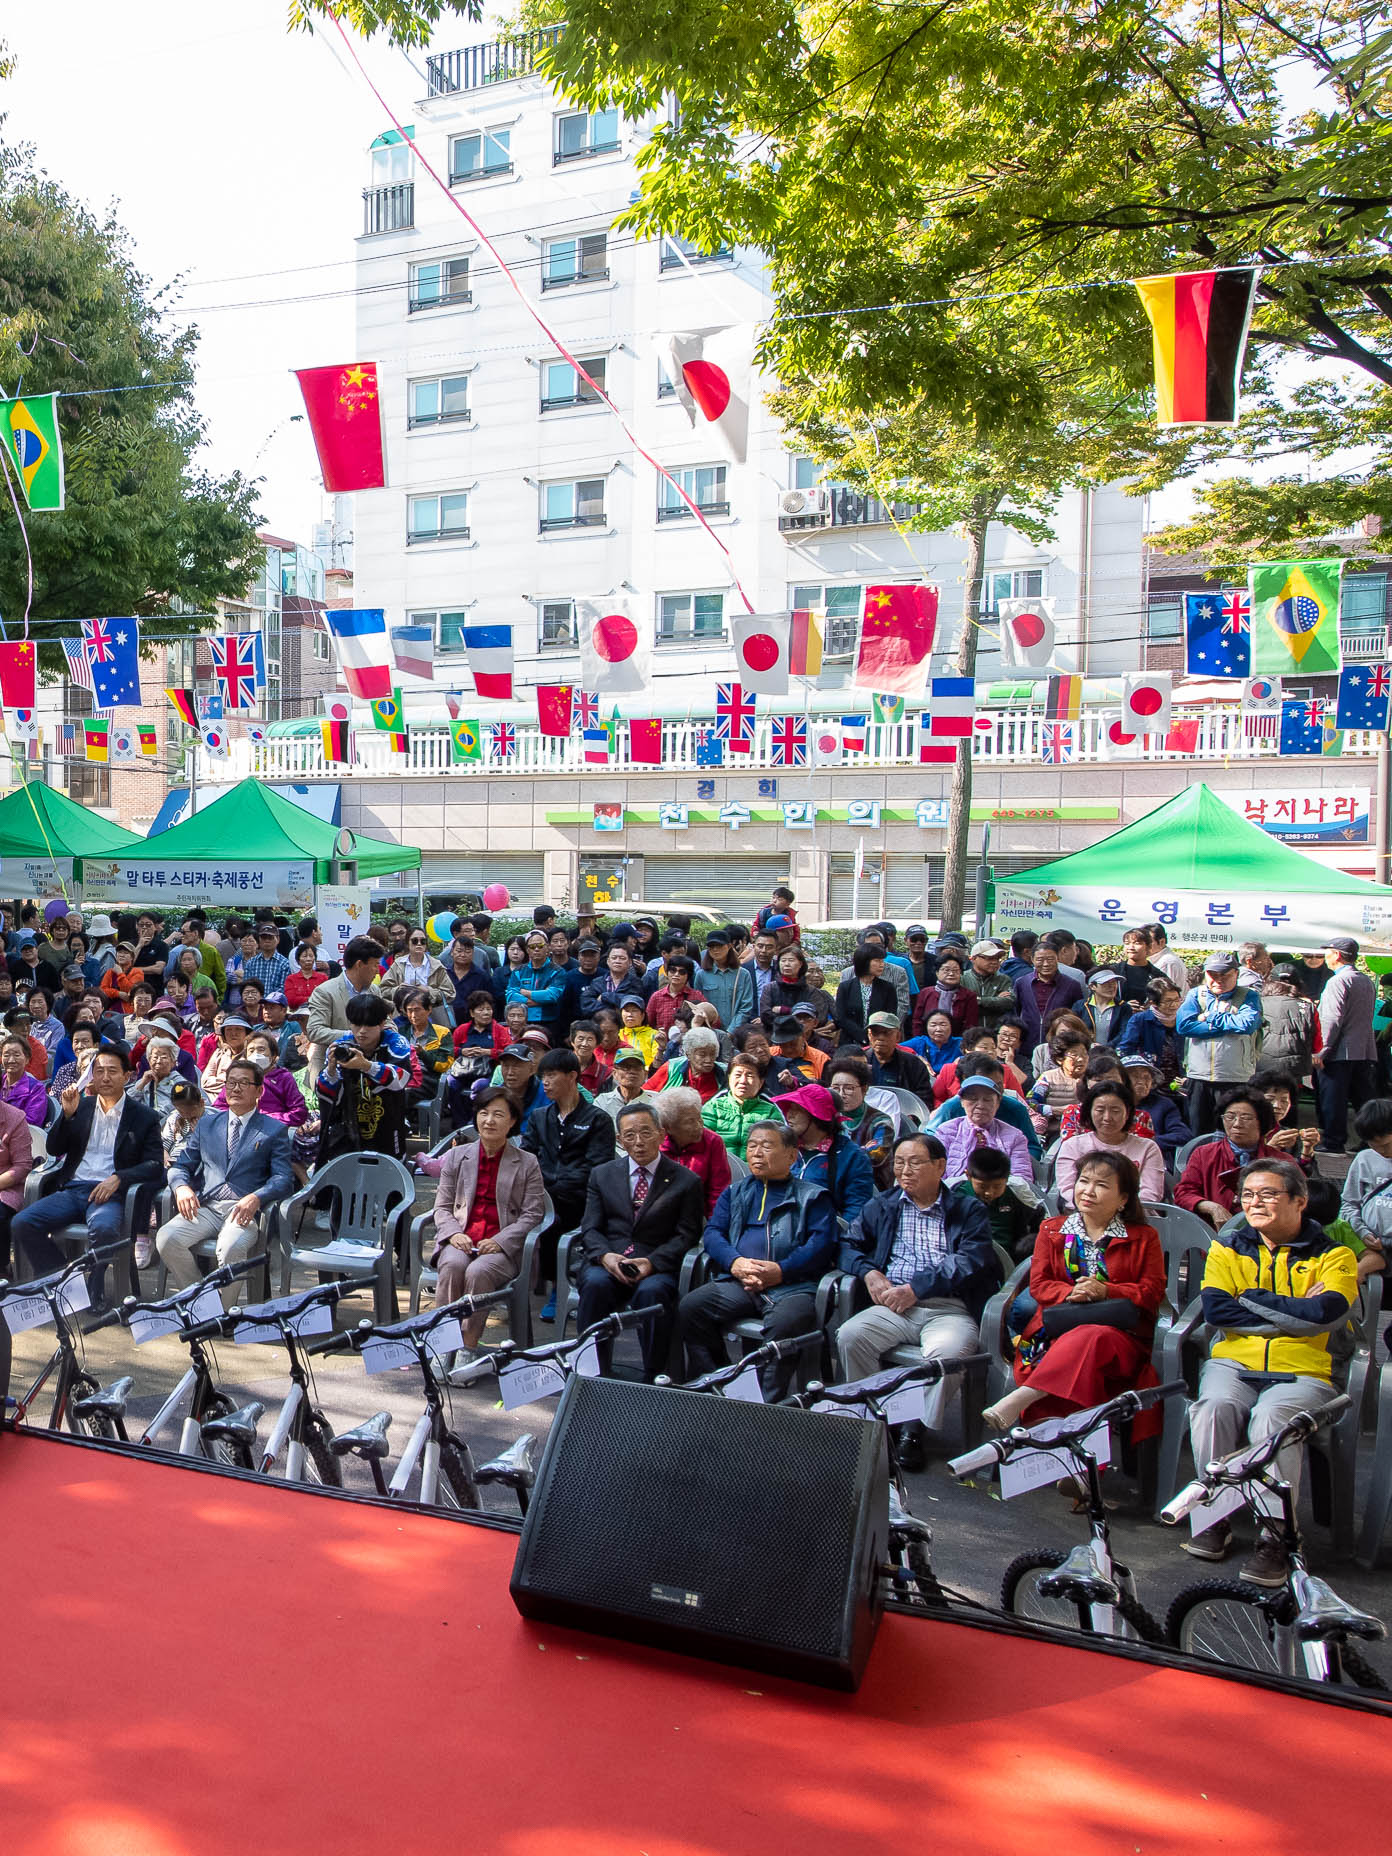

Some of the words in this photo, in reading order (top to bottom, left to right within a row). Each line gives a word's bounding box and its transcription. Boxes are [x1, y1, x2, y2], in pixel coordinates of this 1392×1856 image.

[659, 800, 950, 830] 천수한의원
[992, 808, 1054, 818] 446-1275
[1244, 796, 1360, 825] 낙지나라
[126, 870, 140, 888] 말
[142, 870, 167, 888] 타투
[1000, 909, 1035, 919] 자신만만
[1036, 910, 1053, 920] 축제
[1097, 898, 1292, 927] 운영본부
[337, 924, 353, 940] 말
